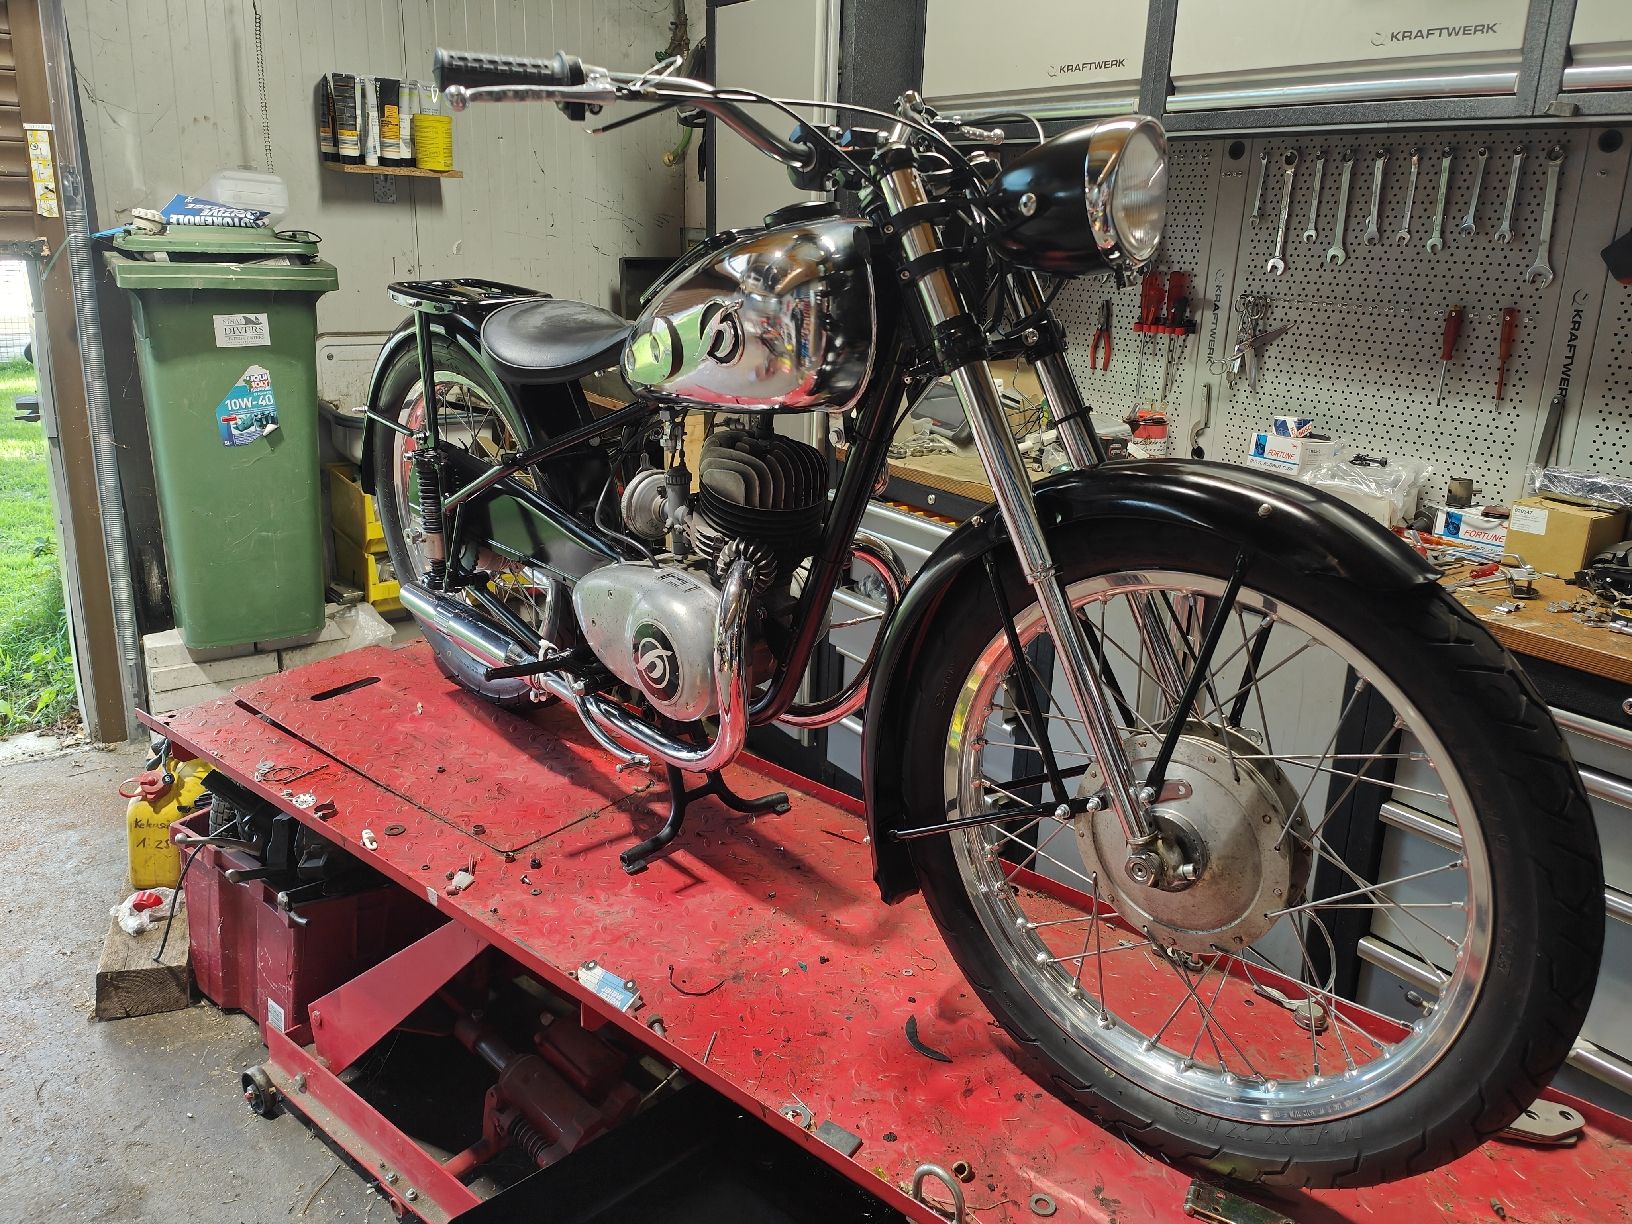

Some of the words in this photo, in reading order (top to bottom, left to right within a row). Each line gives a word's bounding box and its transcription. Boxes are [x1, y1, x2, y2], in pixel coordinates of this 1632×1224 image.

[1390, 22, 1498, 42] KRAFTWERK
[1059, 58, 1126, 74] KRAFTWERK
[224, 325, 264, 335] DIVERS
[1206, 283, 1223, 366] KRAFTWERK
[1556, 308, 1584, 399] KRAFTWER
[225, 394, 274, 411] 10W-40
[1268, 448, 1296, 461] FORTUNE
[1463, 529, 1506, 543] FORTUNE
